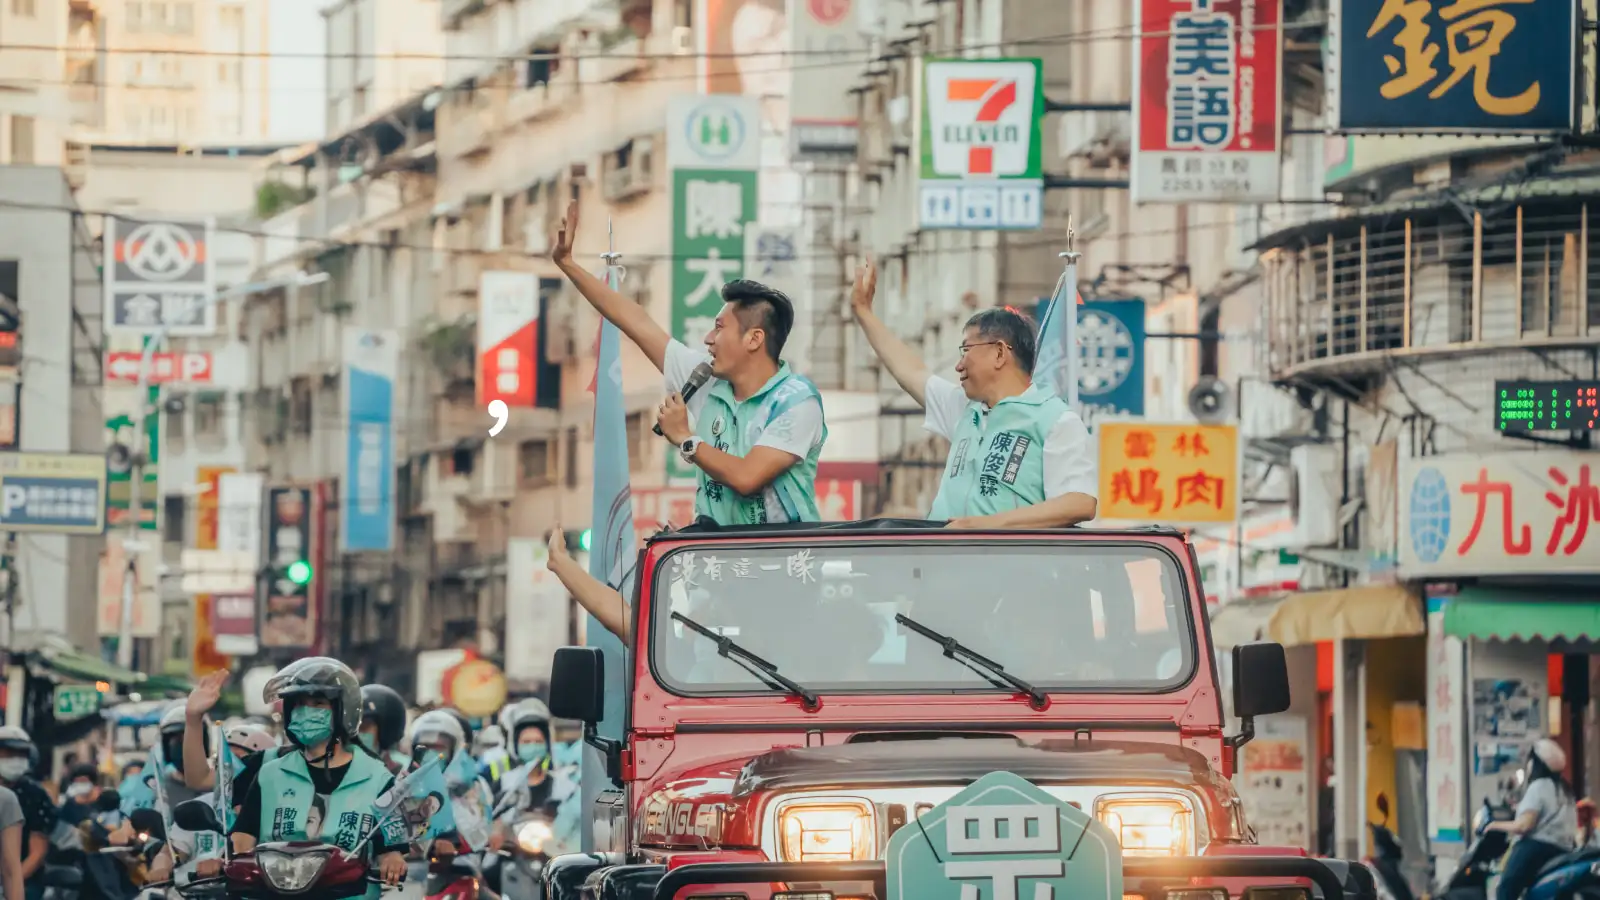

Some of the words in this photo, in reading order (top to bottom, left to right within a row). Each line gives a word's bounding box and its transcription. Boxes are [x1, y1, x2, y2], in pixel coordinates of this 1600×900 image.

[1173, 0, 1230, 145] 美語
[947, 79, 1017, 174] 7
[282, 807, 298, 837] 助理
